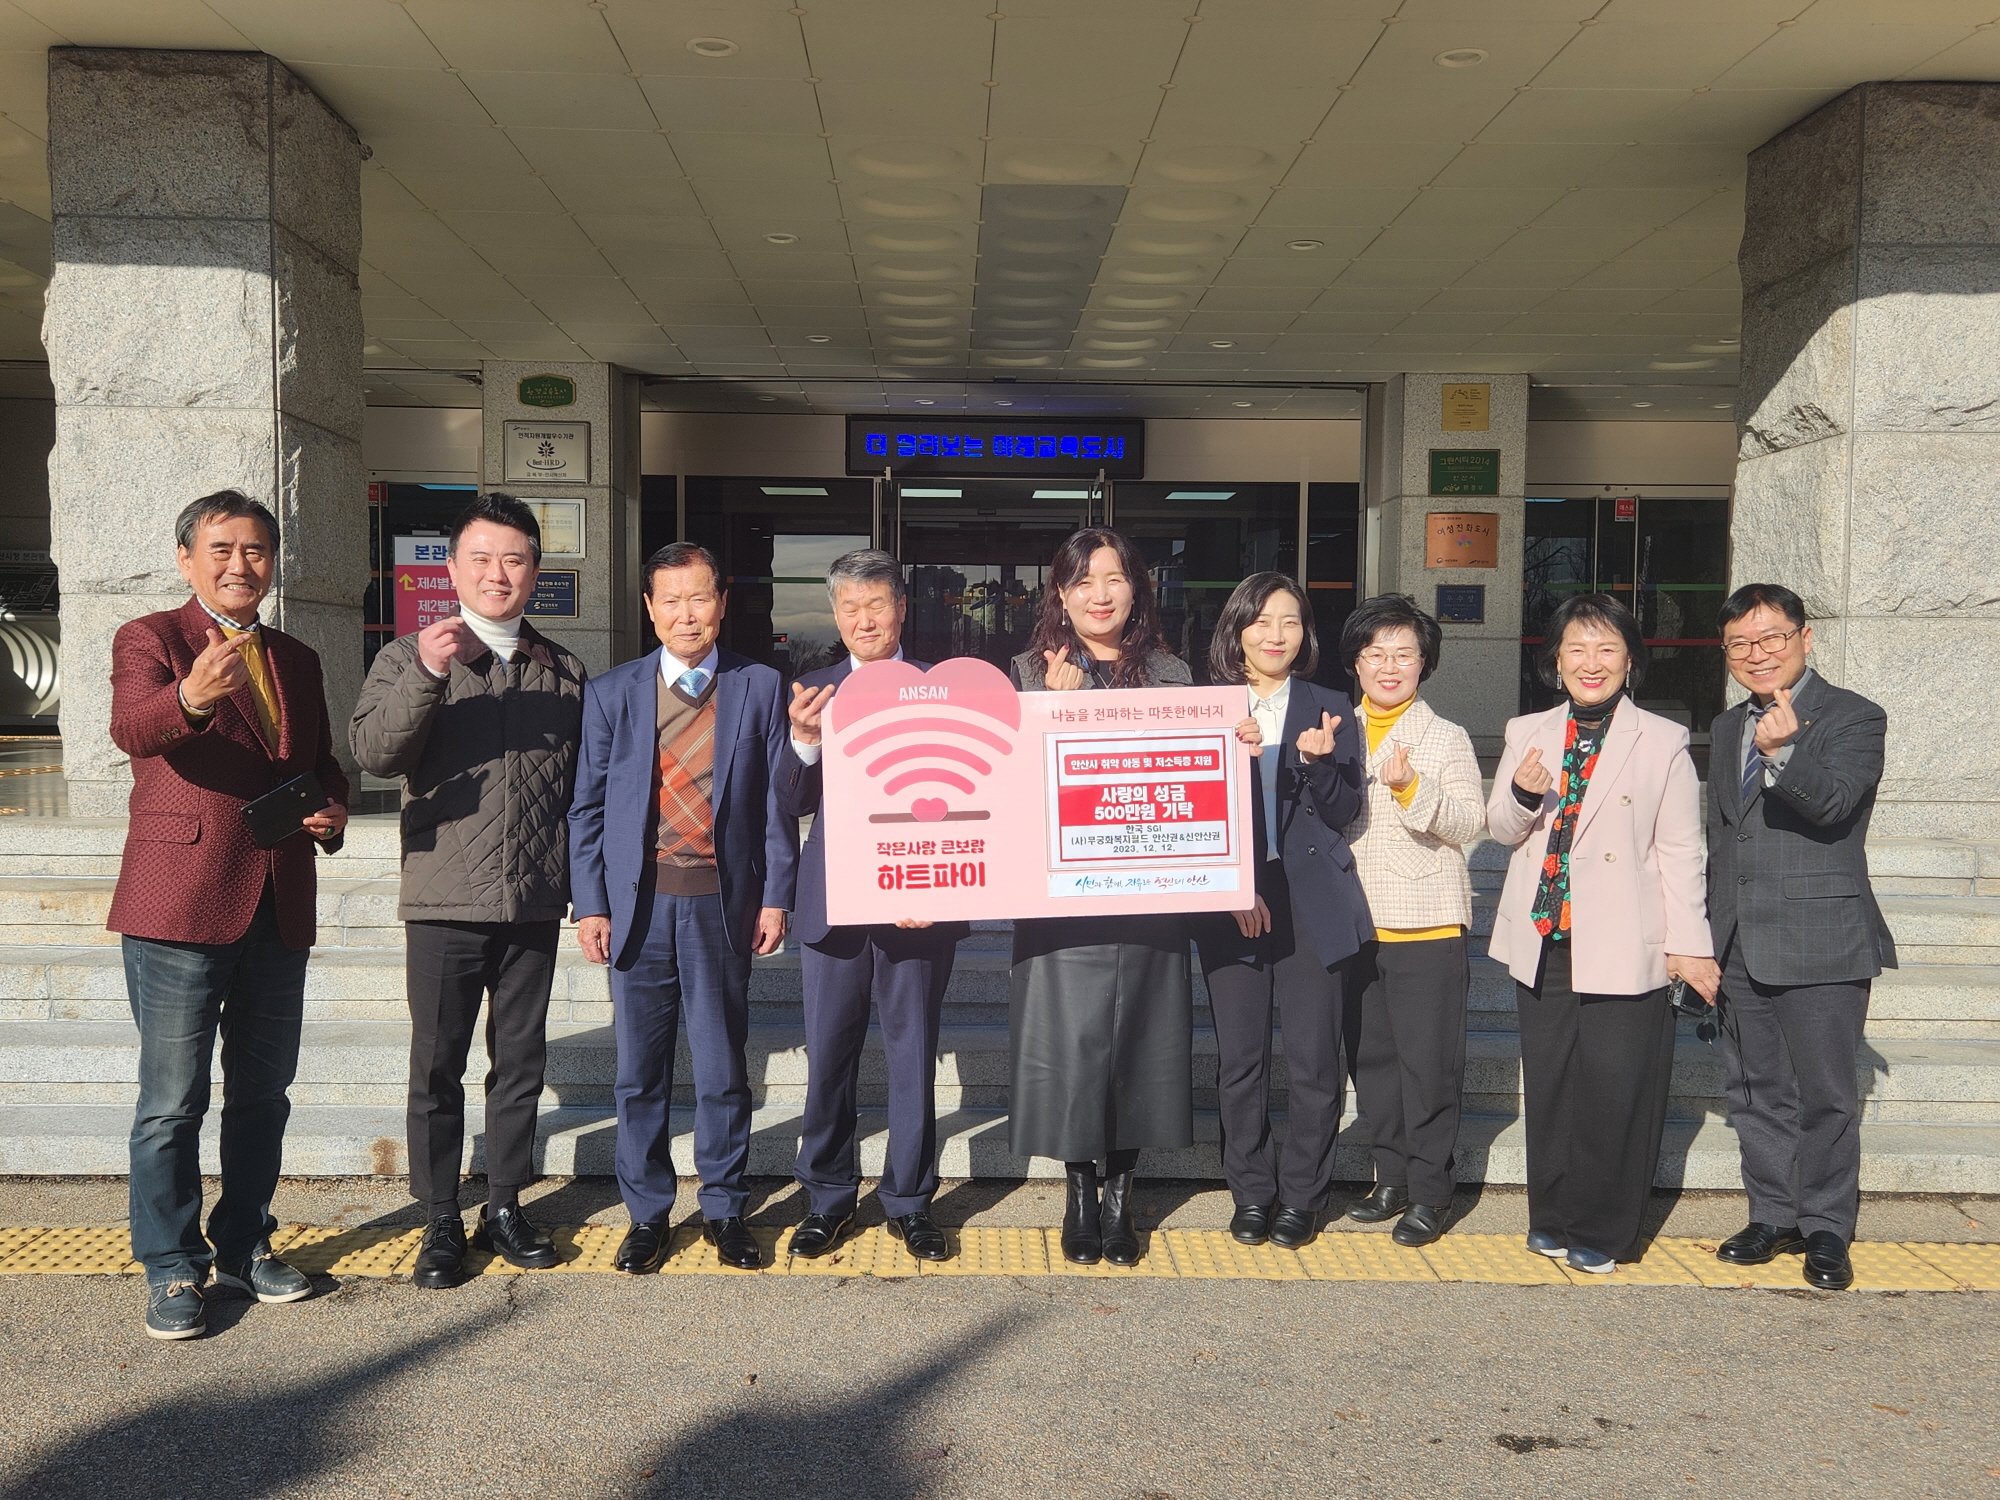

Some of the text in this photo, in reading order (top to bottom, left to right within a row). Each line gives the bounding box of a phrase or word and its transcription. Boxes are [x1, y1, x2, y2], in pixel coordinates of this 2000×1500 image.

[866, 434, 1125, 459] 더 멀리보는 미래교육도시
[1437, 523, 1490, 537] 여성친화도시
[414, 544, 447, 561] 본관
[899, 685, 949, 701] ANSAN
[1051, 704, 1224, 722] 나눔을 전파하는 따뜻한에너지
[1070, 755, 1213, 770] 안산시 취약 아동 및 저소득층 지원
[1101, 785, 1186, 804] 사랑의 성금
[1094, 802, 1194, 821] 500만원 기탁
[1125, 825, 1144, 834] 한국
[1152, 831, 1221, 843] 안산권&신안산권
[876, 839, 986, 857] 작은사랑 큰보람
[1113, 843, 1176, 854] 2023. 12. 12.
[877, 861, 986, 891] 하트파이
[1186, 874, 1211, 886] 안산
